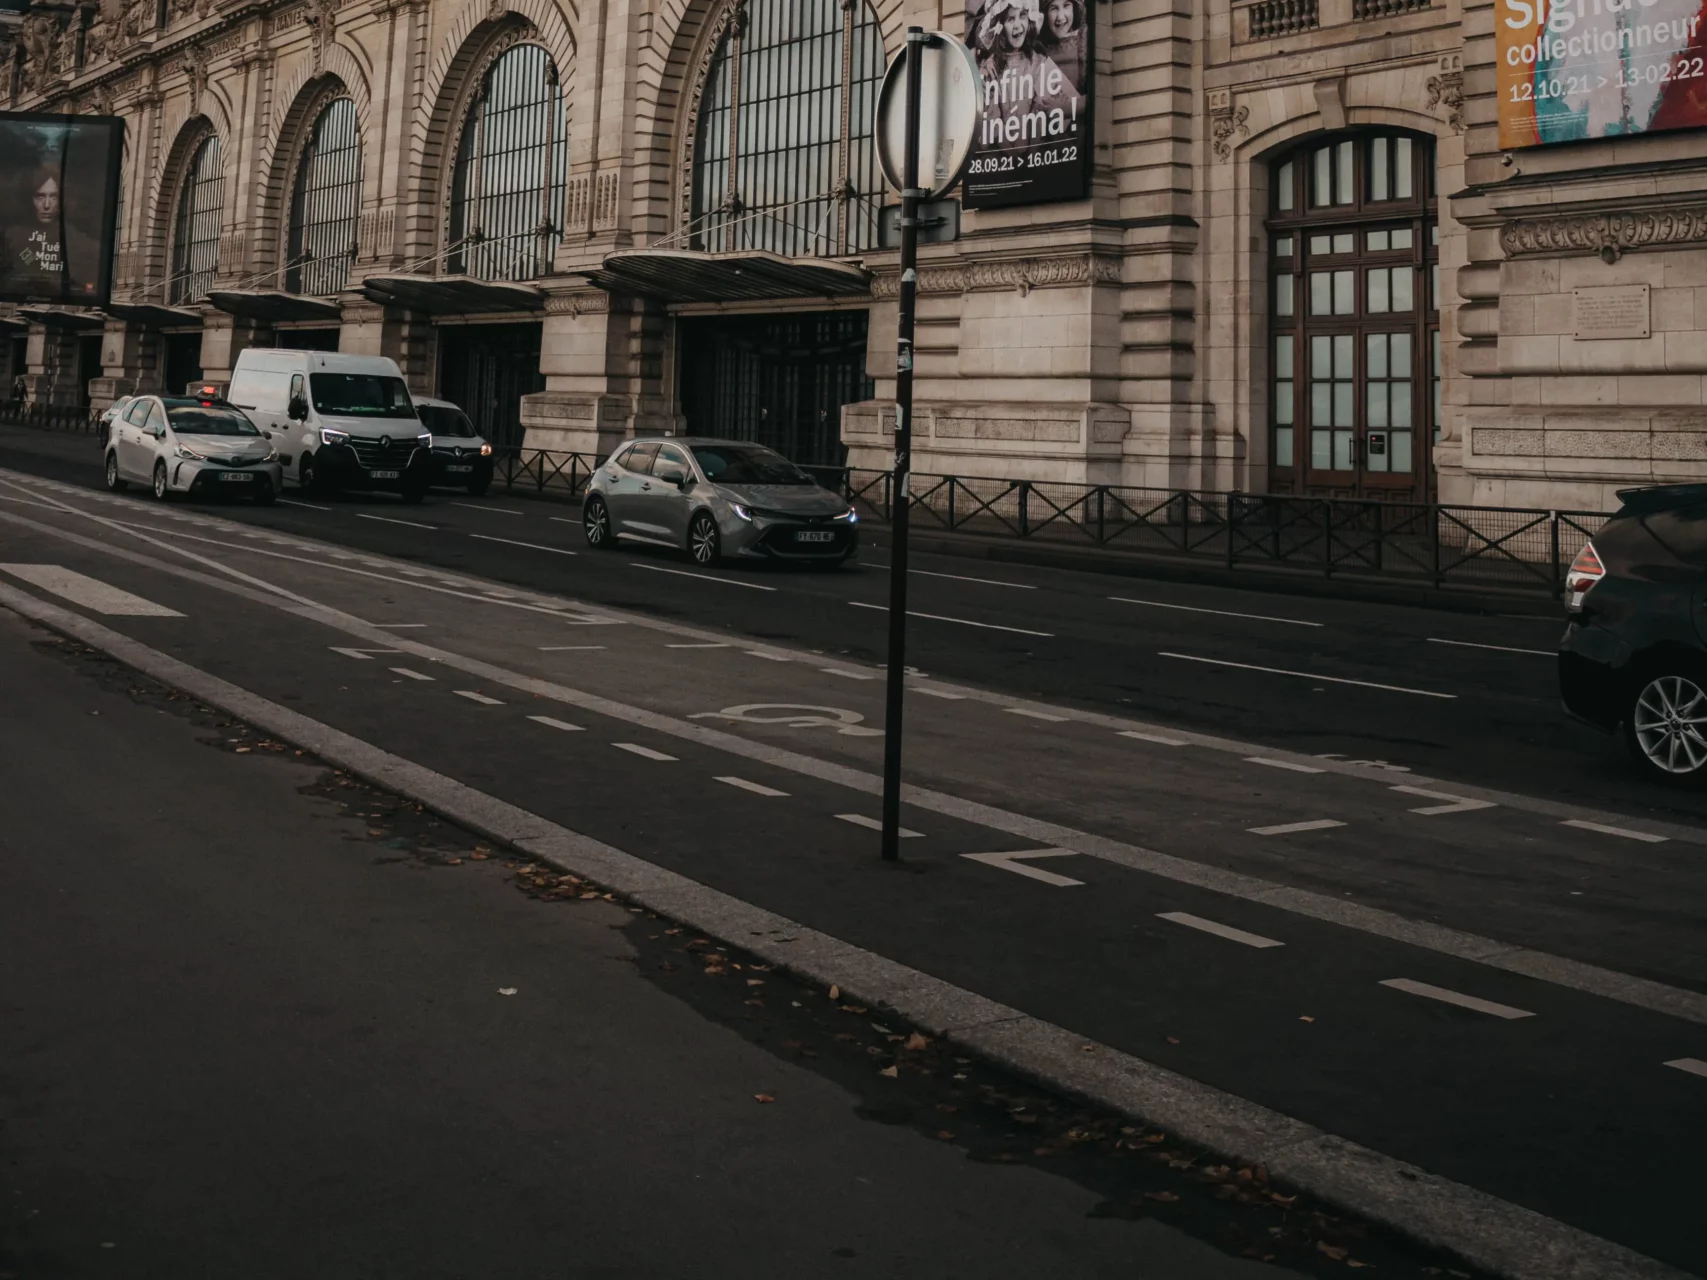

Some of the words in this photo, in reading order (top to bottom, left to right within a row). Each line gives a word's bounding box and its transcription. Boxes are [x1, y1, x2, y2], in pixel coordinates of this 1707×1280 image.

[1506, 14, 1701, 67] collectionneur
[980, 68, 1034, 106] nfin
[1039, 63, 1063, 97] le
[1509, 74, 1593, 103] 12.10.21
[980, 104, 1064, 145] inéma
[1027, 145, 1077, 168] 16.01.22
[35, 251, 58, 261] Mon
[41, 241, 60, 252] Tué
[40, 261, 64, 272] Mari
